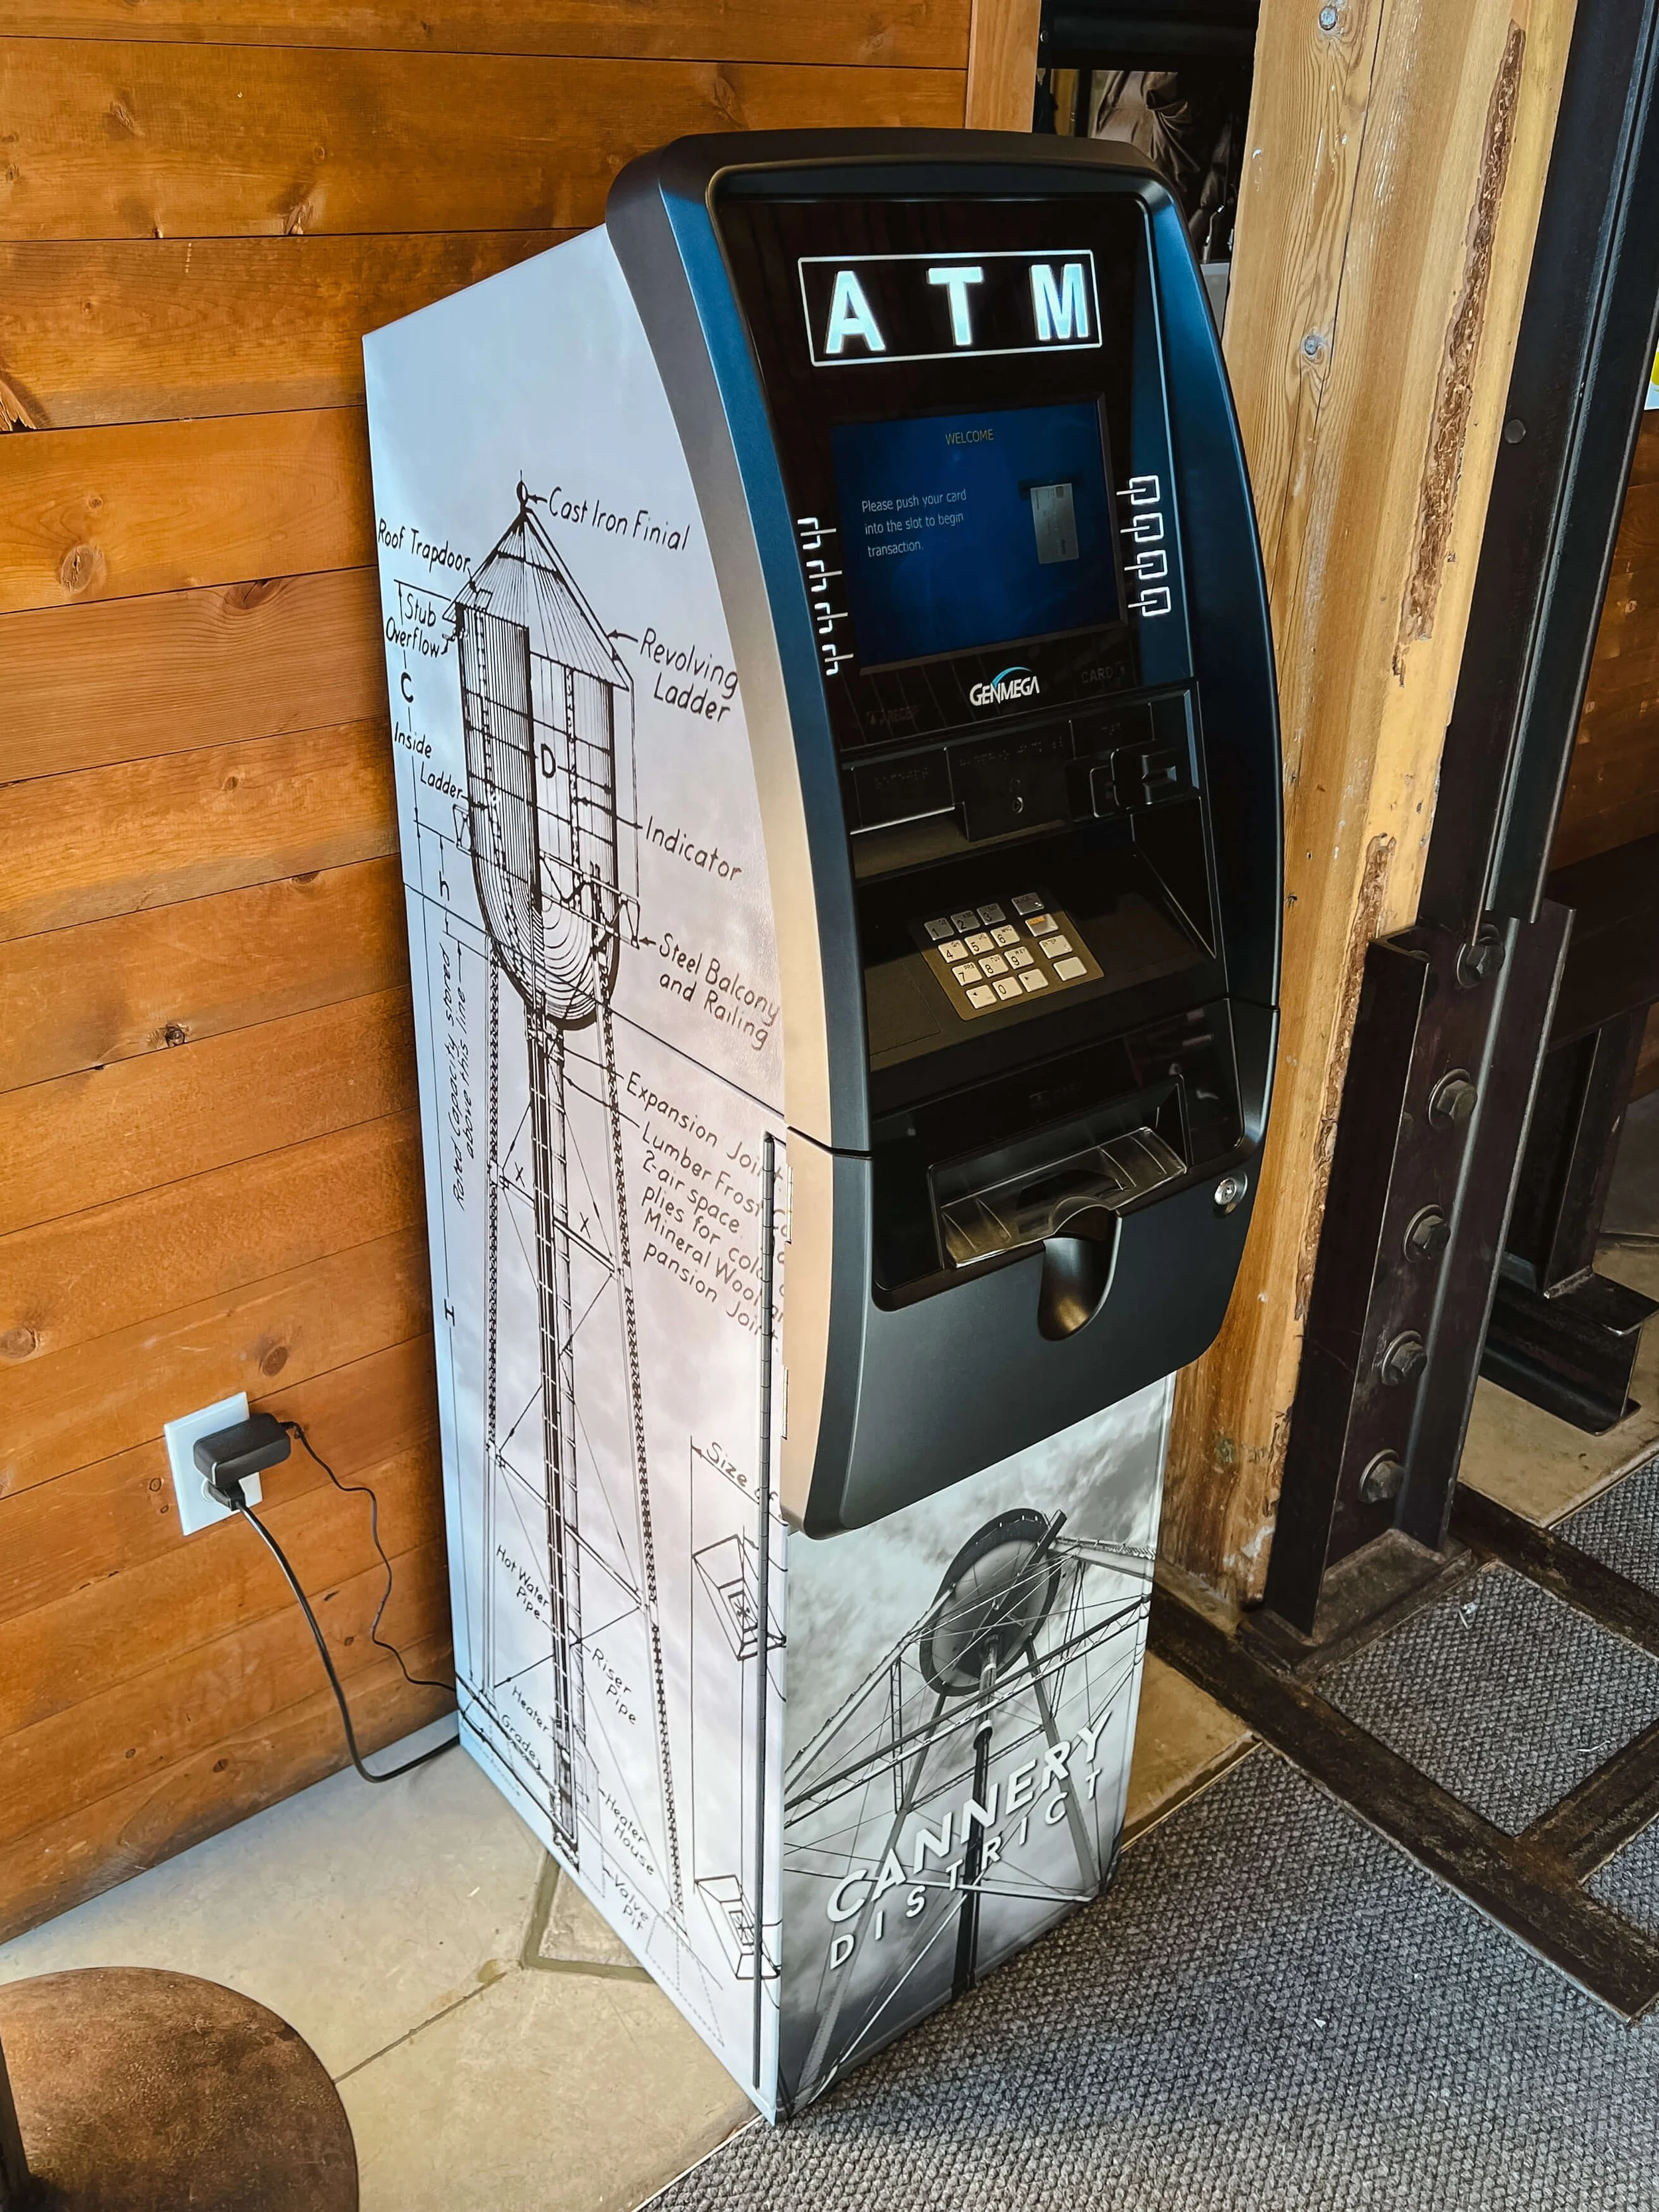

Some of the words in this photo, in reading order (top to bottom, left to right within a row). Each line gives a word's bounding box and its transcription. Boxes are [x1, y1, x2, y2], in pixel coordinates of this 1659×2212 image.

[825, 263, 1089, 354] ATM
[945, 429, 994, 445] WELCOME
[549, 486, 588, 524] Cast
[592, 500, 628, 535] Iron
[632, 510, 690, 551] Finial
[862, 500, 894, 513] Please
[896, 495, 919, 512] push
[922, 494, 943, 508] your
[946, 488, 967, 502] card
[378, 518, 405, 549] Roof
[411, 528, 470, 573] Trapdoor
[865, 521, 884, 536] into
[887, 519, 903, 533] the
[905, 517, 922, 530] slot
[925, 516, 936, 527] to
[938, 512, 964, 526] begin
[867, 540, 924, 557] transaction.
[405, 593, 436, 627] Stub
[386, 617, 440, 658] Overflow
[640, 628, 739, 700] Revolving
[401, 672, 413, 703] C
[654, 670, 731, 723] Ladder
[970, 676, 1040, 706] GENMEGA
[394, 721, 432, 759] Inside
[540, 744, 556, 779] D
[420, 761, 463, 799] Ladder
[646, 816, 742, 882] Indicator
[957, 919, 967, 929] 2
[983, 912, 992, 922] 3
[997, 934, 1006, 944] 6
[946, 950, 954, 959] 4
[971, 942, 979, 952] 5
[985, 964, 993, 974] 8
[1011, 956, 1019, 966] 9
[439, 942, 454, 1026] stored
[659, 932, 702, 974] Steel
[705, 958, 780, 1027] Balcony
[958, 972, 966, 982] 7
[998, 984, 1006, 994] 0
[456, 987, 467, 1034] line
[660, 974, 697, 1002] and
[703, 990, 768, 1051] Railing
[444, 1033, 463, 1136] Capacity
[458, 1039, 469, 1086] this
[463, 1089, 474, 1159] above
[626, 1070, 717, 1147] Expansion
[451, 1136, 465, 1211] Rated
[642, 1121, 712, 1180] Lumber
[642, 1149, 685, 1190] 2-air
[641, 1186, 685, 1223] plies
[692, 1215, 721, 1244] for
[643, 1242, 717, 1302] pansion
[644, 1207, 711, 1268] Mineral
[715, 1257, 762, 1305] Wool
[444, 1298, 455, 1327] H
[707, 1441, 747, 1487] Size
[496, 1544, 516, 1572] Hot
[519, 1567, 549, 1606] Water
[516, 1586, 540, 1619] Pipe
[592, 1648, 632, 1693] Riser
[512, 1686, 549, 1732] Heater
[501, 1715, 536, 1760] Grade
[605, 1793, 645, 1843] Heater
[826, 1711, 1113, 1922] CANNERY
[614, 1823, 654, 1875] House
[830, 1768, 1101, 1971] DISTRICT
[615, 1874, 648, 1921] Valve
